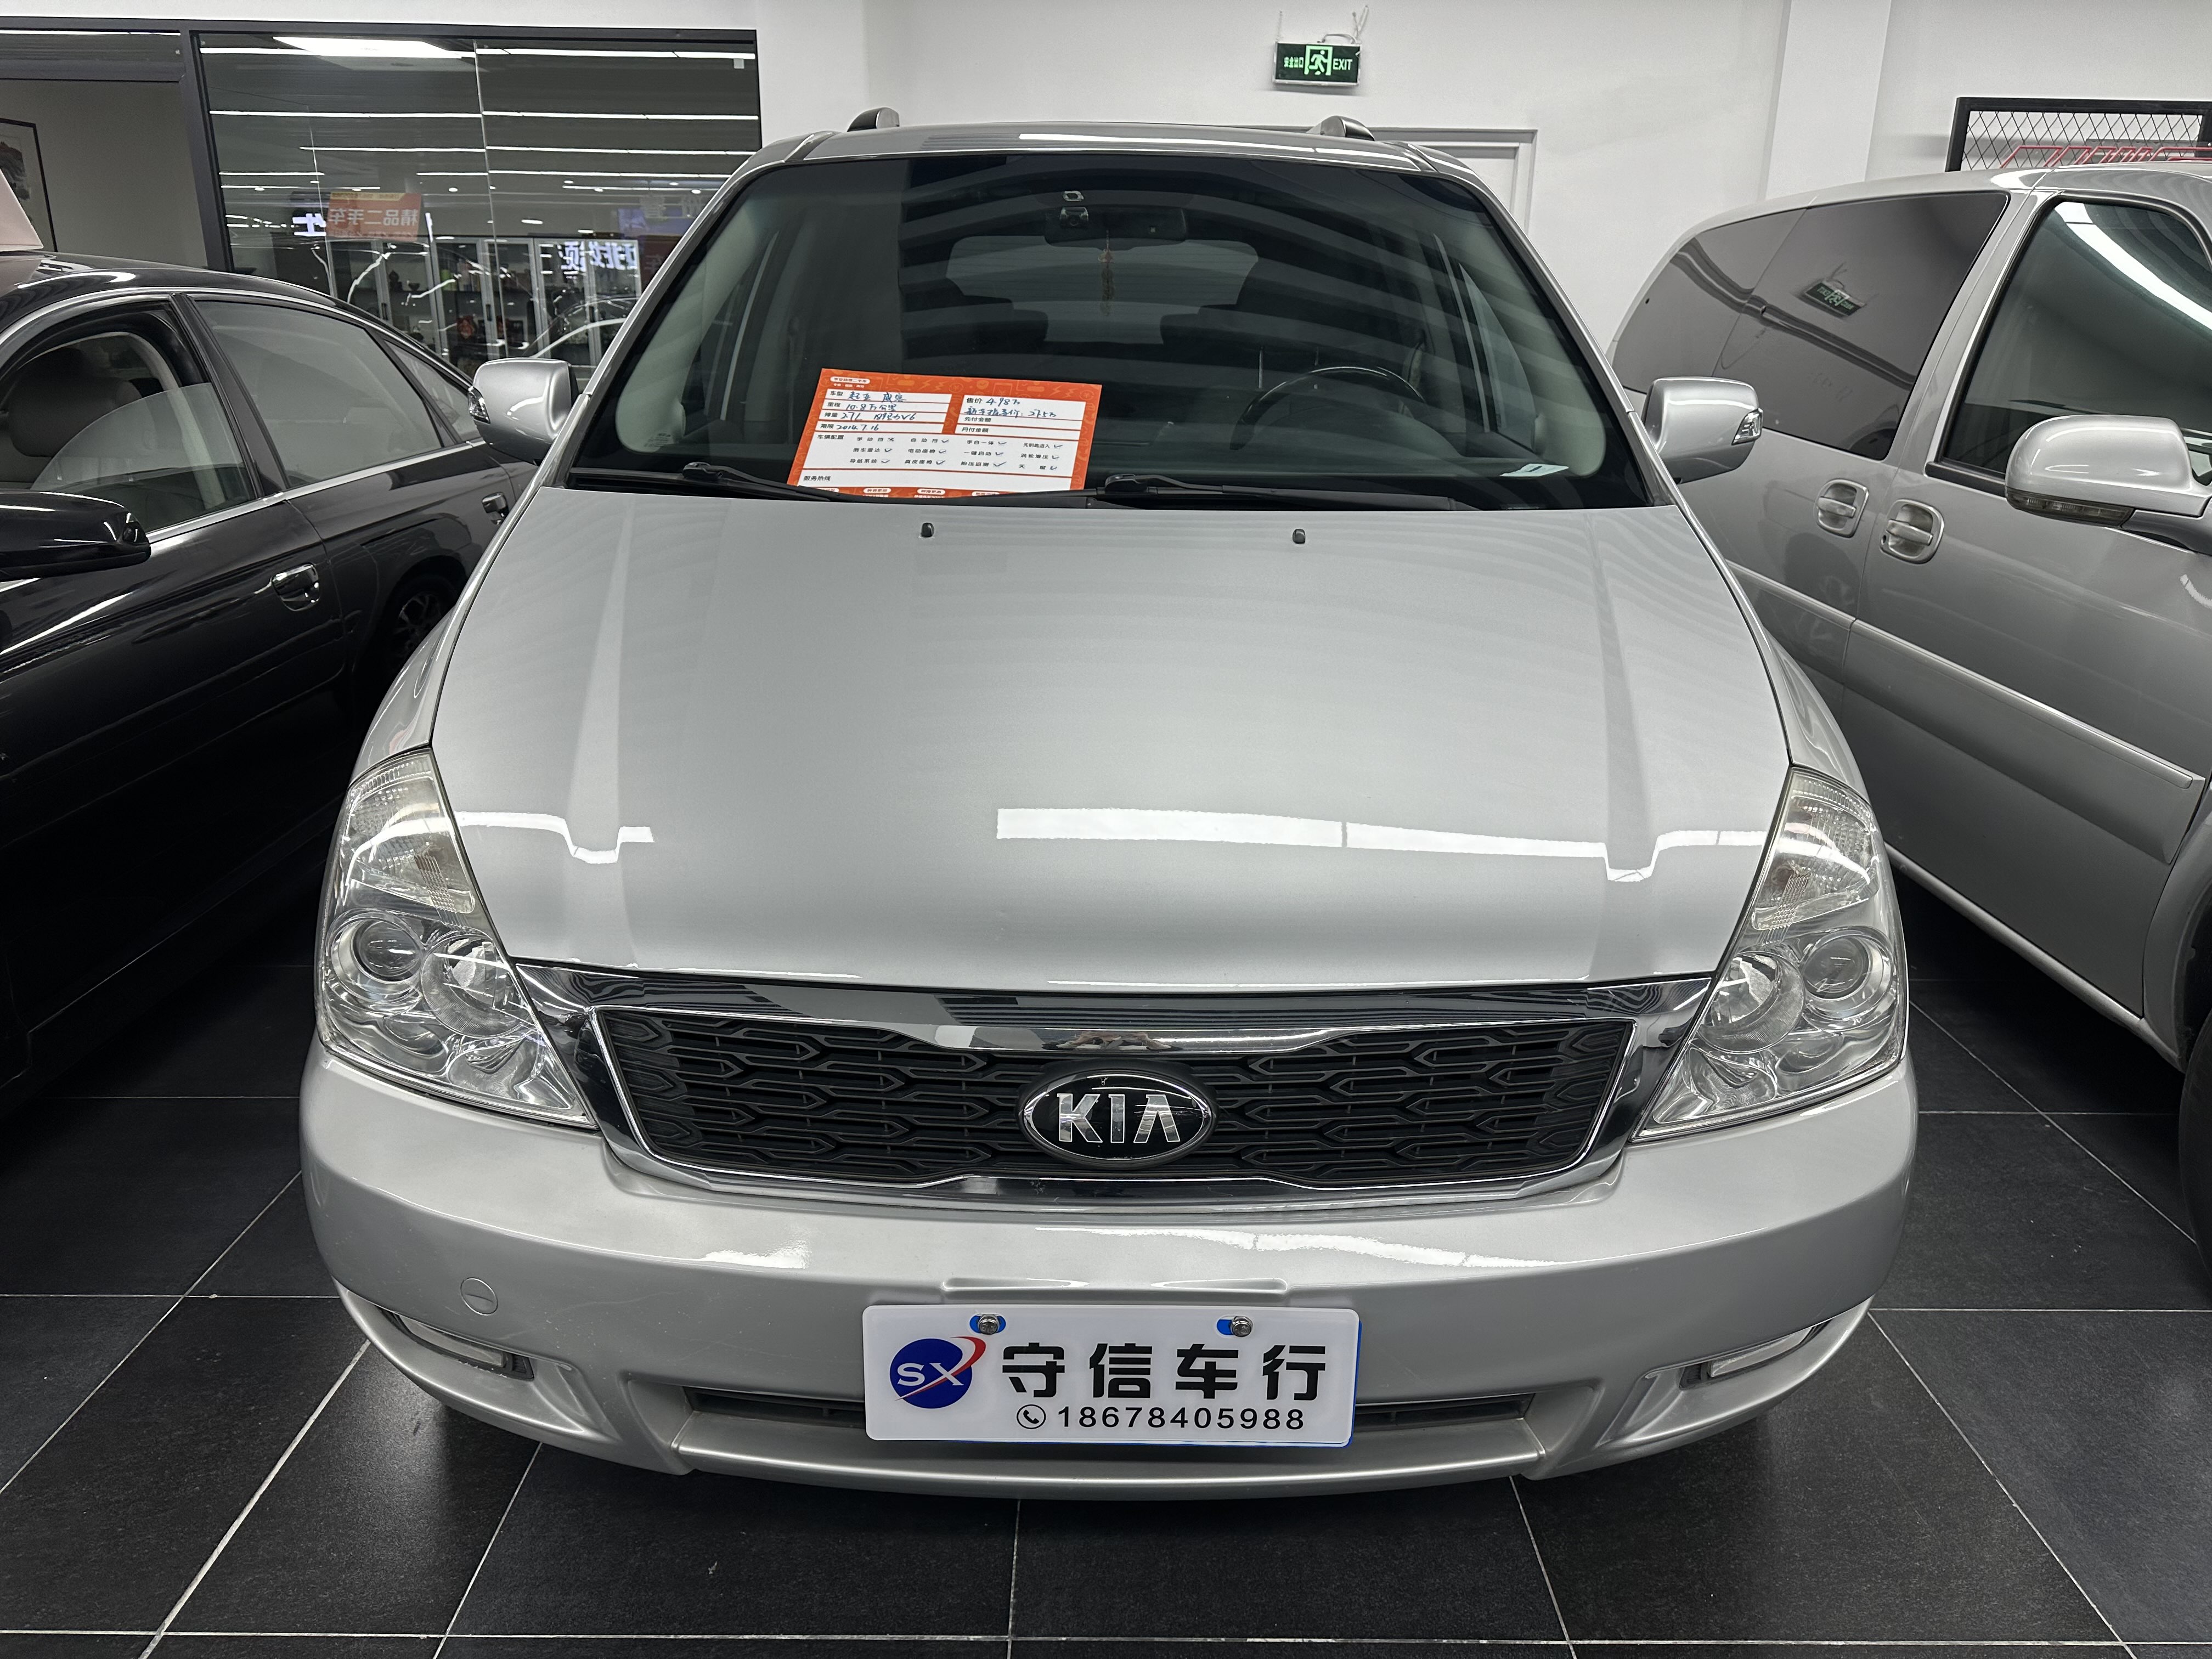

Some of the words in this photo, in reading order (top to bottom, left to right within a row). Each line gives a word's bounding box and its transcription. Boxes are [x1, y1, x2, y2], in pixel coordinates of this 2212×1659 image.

[1333, 59, 1353, 71] EXIT
[1057, 1093, 1181, 1143] KIA
[897, 1363, 964, 1386] SX
[1002, 1342, 1325, 1401] 守信车行
[1058, 1406, 1304, 1430] 18678405988
